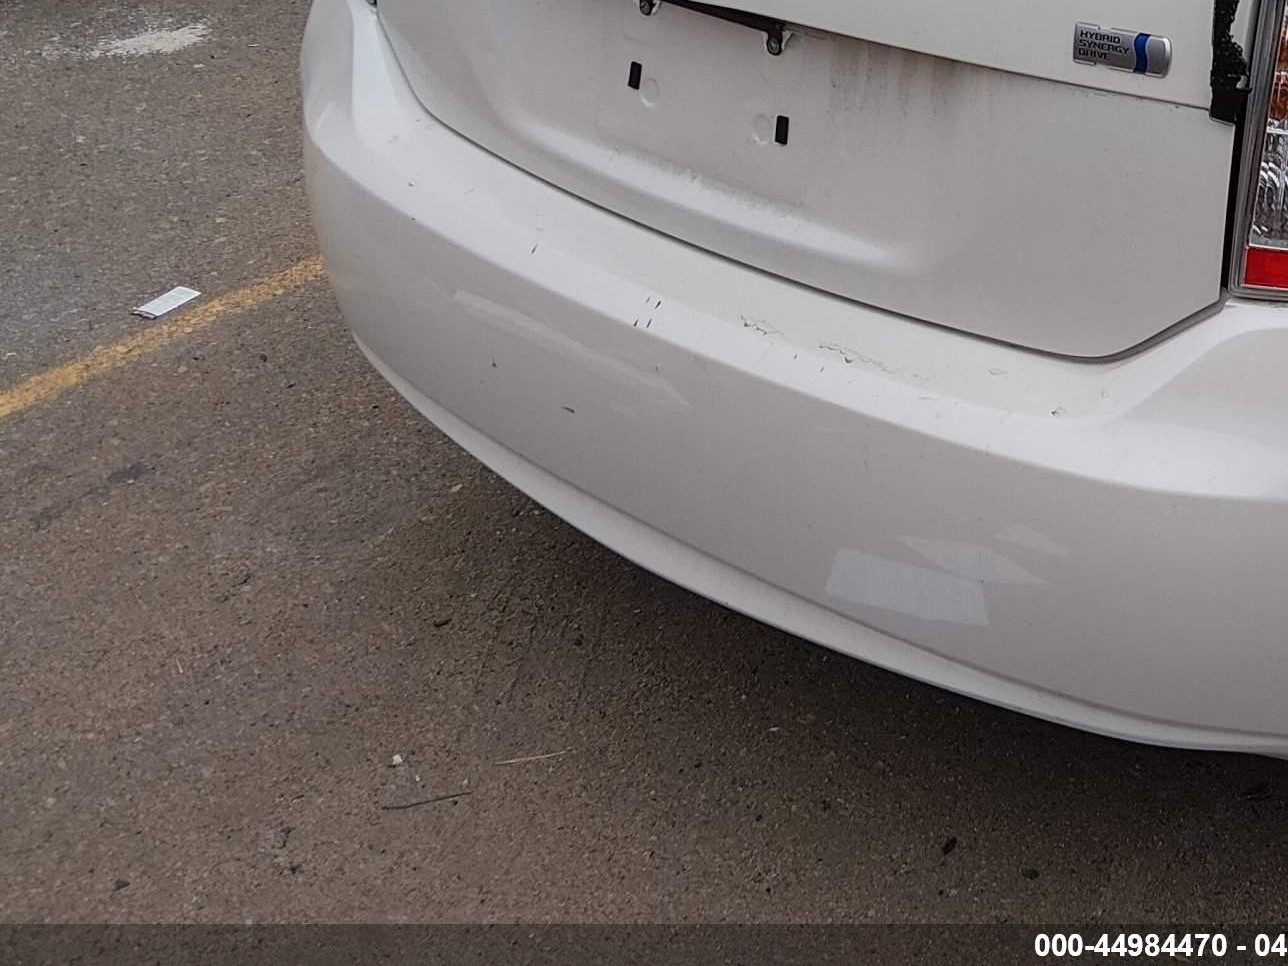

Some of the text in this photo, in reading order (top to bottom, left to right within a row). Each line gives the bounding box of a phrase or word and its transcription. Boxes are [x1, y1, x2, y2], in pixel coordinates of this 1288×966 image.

[1080, 30, 1121, 44] HYBRID
[1079, 39, 1130, 54] SYNERGY
[1078, 48, 1109, 60] DRIVE
